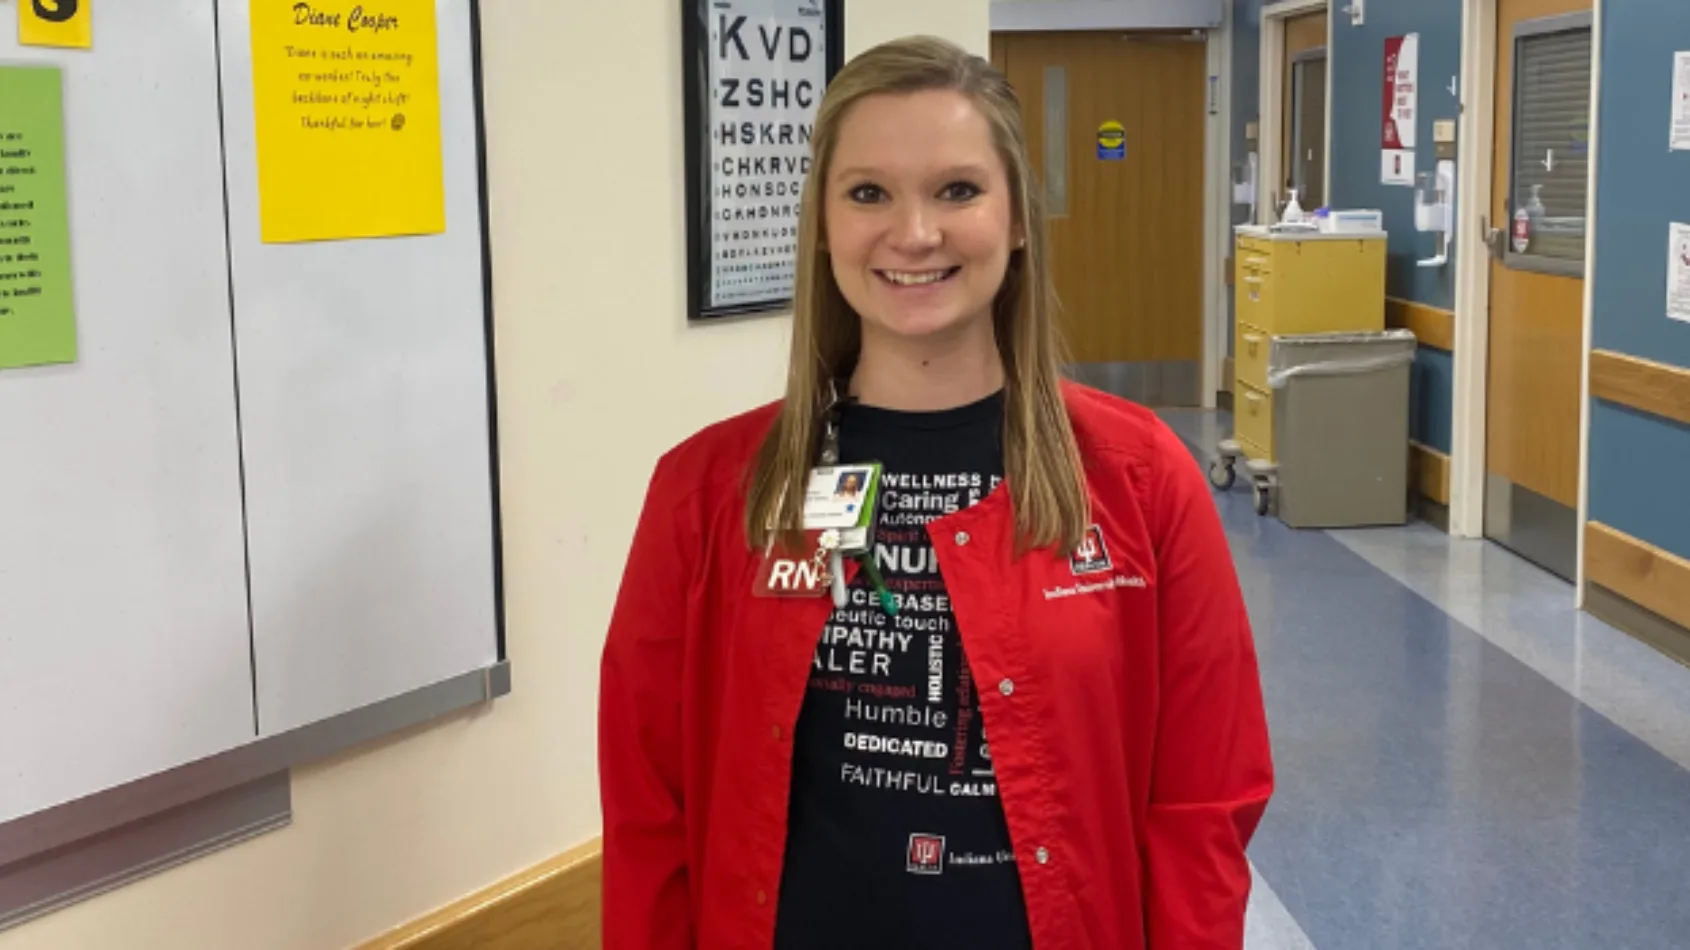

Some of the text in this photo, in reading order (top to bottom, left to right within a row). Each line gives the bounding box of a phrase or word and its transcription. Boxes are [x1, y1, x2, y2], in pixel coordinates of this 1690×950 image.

[293, 2, 399, 34] Diane Cooper
[719, 77, 813, 109] ZSHC
[881, 472, 981, 489] WELLNESS
[881, 489, 960, 514] Caring
[767, 559, 819, 589] RN
[894, 614, 949, 632] touch
[927, 634, 944, 703] HOLISTIC
[845, 697, 949, 728] Humble
[843, 732, 949, 759] DEDICATED
[841, 762, 946, 795] FAITHFUL
[950, 783, 997, 797] CALM
